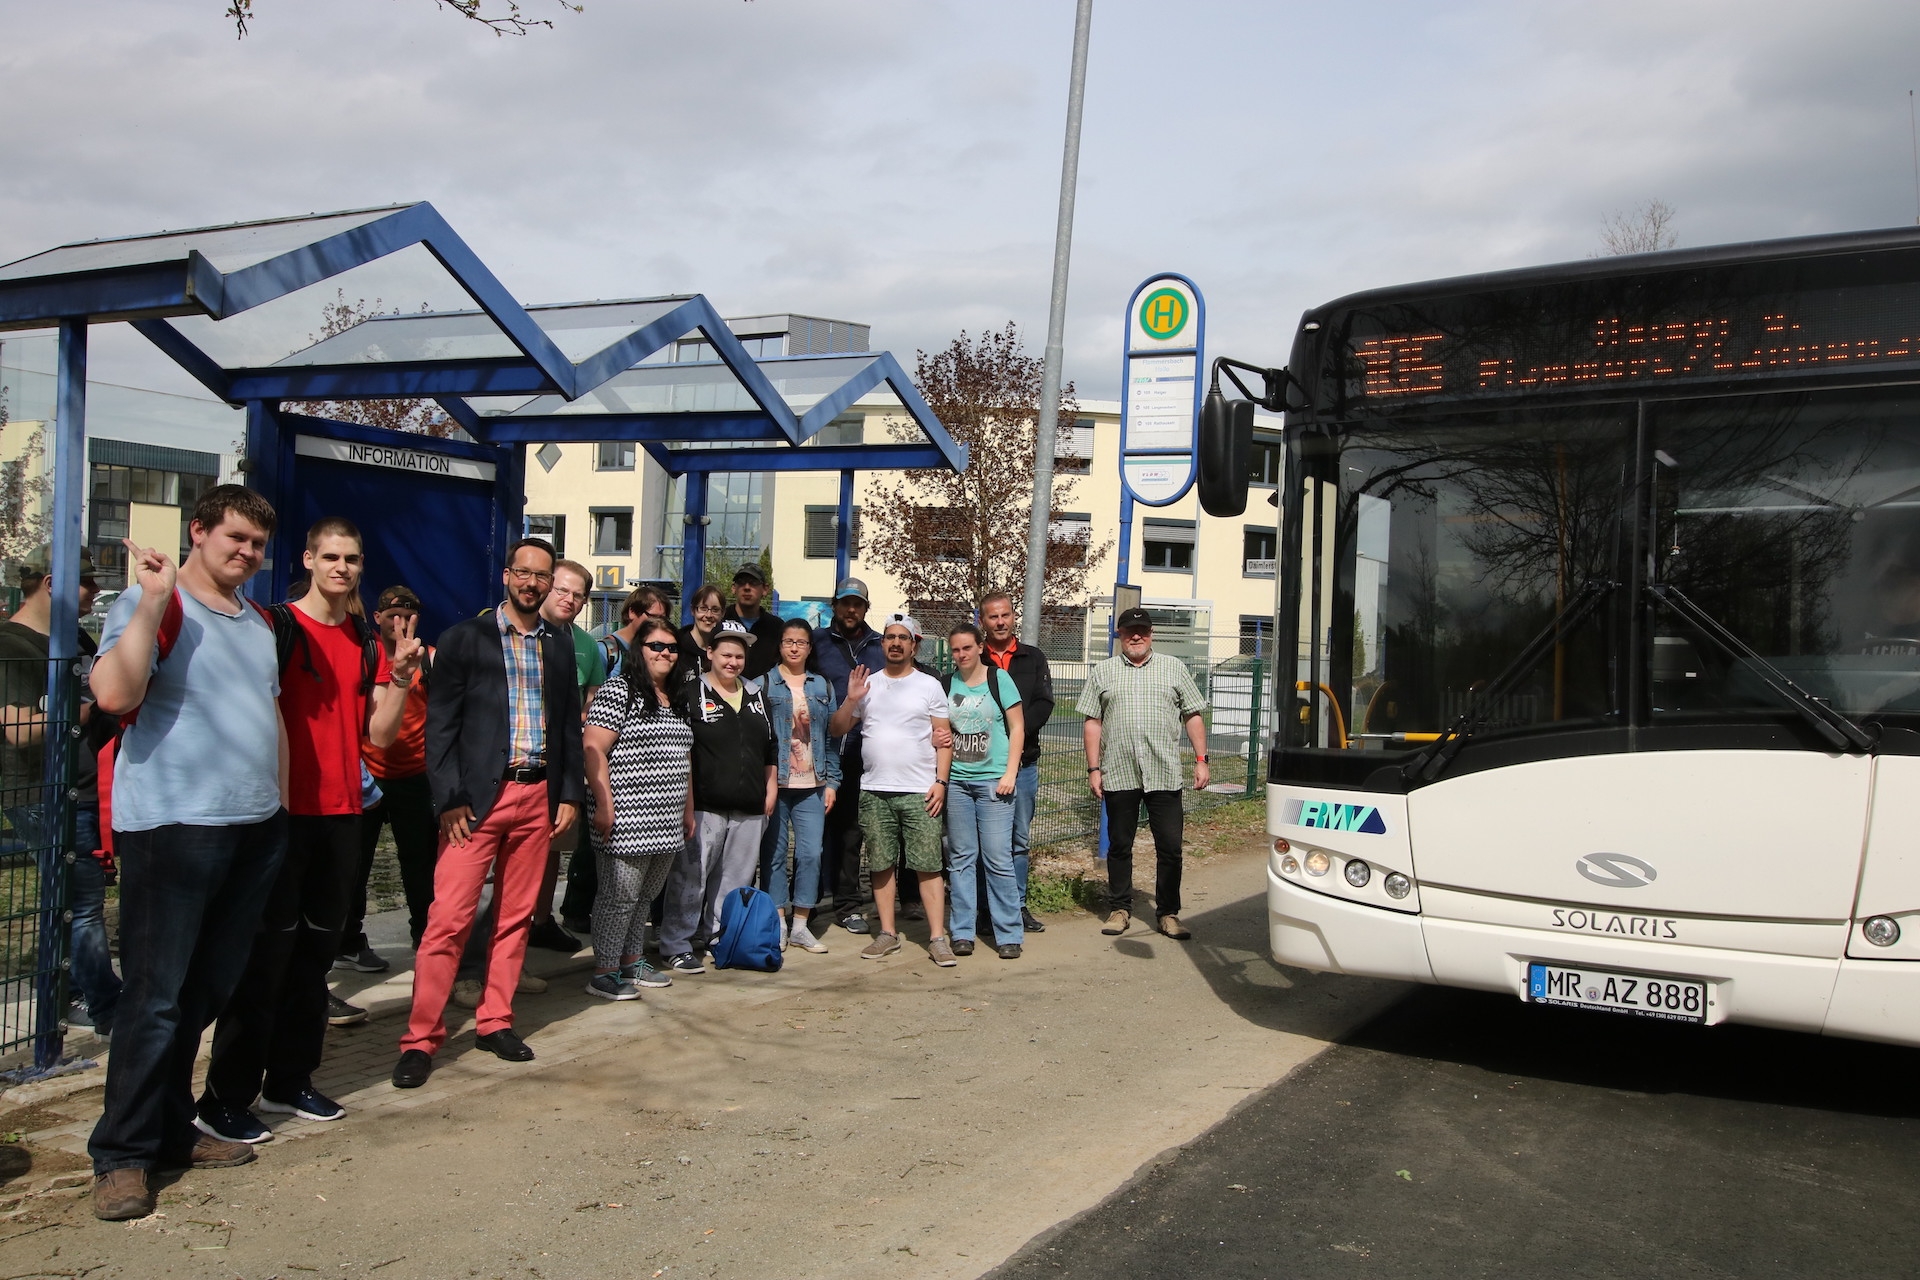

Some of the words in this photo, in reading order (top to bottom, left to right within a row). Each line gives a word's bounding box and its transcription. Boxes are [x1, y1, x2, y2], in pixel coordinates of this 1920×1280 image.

[1153, 299, 1175, 328] H
[349, 444, 450, 473] INFORMATION
[1297, 800, 1376, 832] RMV
[1551, 909, 1677, 939] SOLARIS
[1535, 984, 1542, 992] D
[1548, 970, 1582, 998] MR
[1602, 977, 1638, 1005] AZ
[1646, 982, 1700, 1012] 888
[1548, 999, 1579, 1008] SOLARIS
[1580, 1003, 1611, 1012] Deutschland
